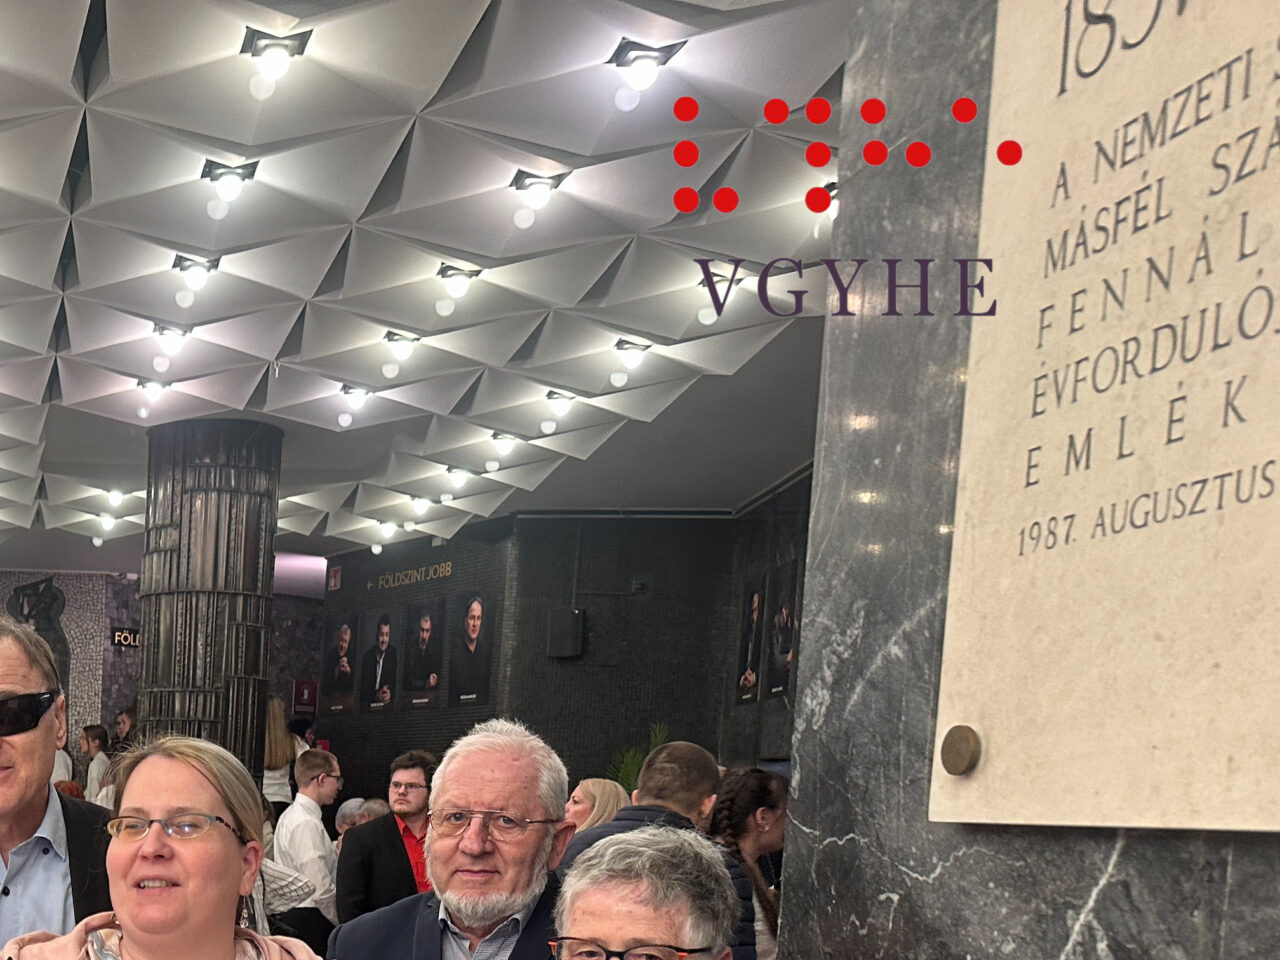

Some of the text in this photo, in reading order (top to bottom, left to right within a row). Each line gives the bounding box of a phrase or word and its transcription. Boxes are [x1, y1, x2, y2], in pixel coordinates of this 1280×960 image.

[1051, 160, 1071, 208] A
[1093, 47, 1254, 184] NEMZETI
[1036, 210, 1259, 350] FENNÁL
[1043, 169, 1173, 280] MÁSFÉL
[1030, 267, 1280, 419] ÉVFORDULÓ
[1024, 374, 1248, 489] EMLÉK
[1017, 459, 1277, 557] 1987. AUGUSZTUS
[378, 561, 453, 590] FÖLDSZINT JOBB
